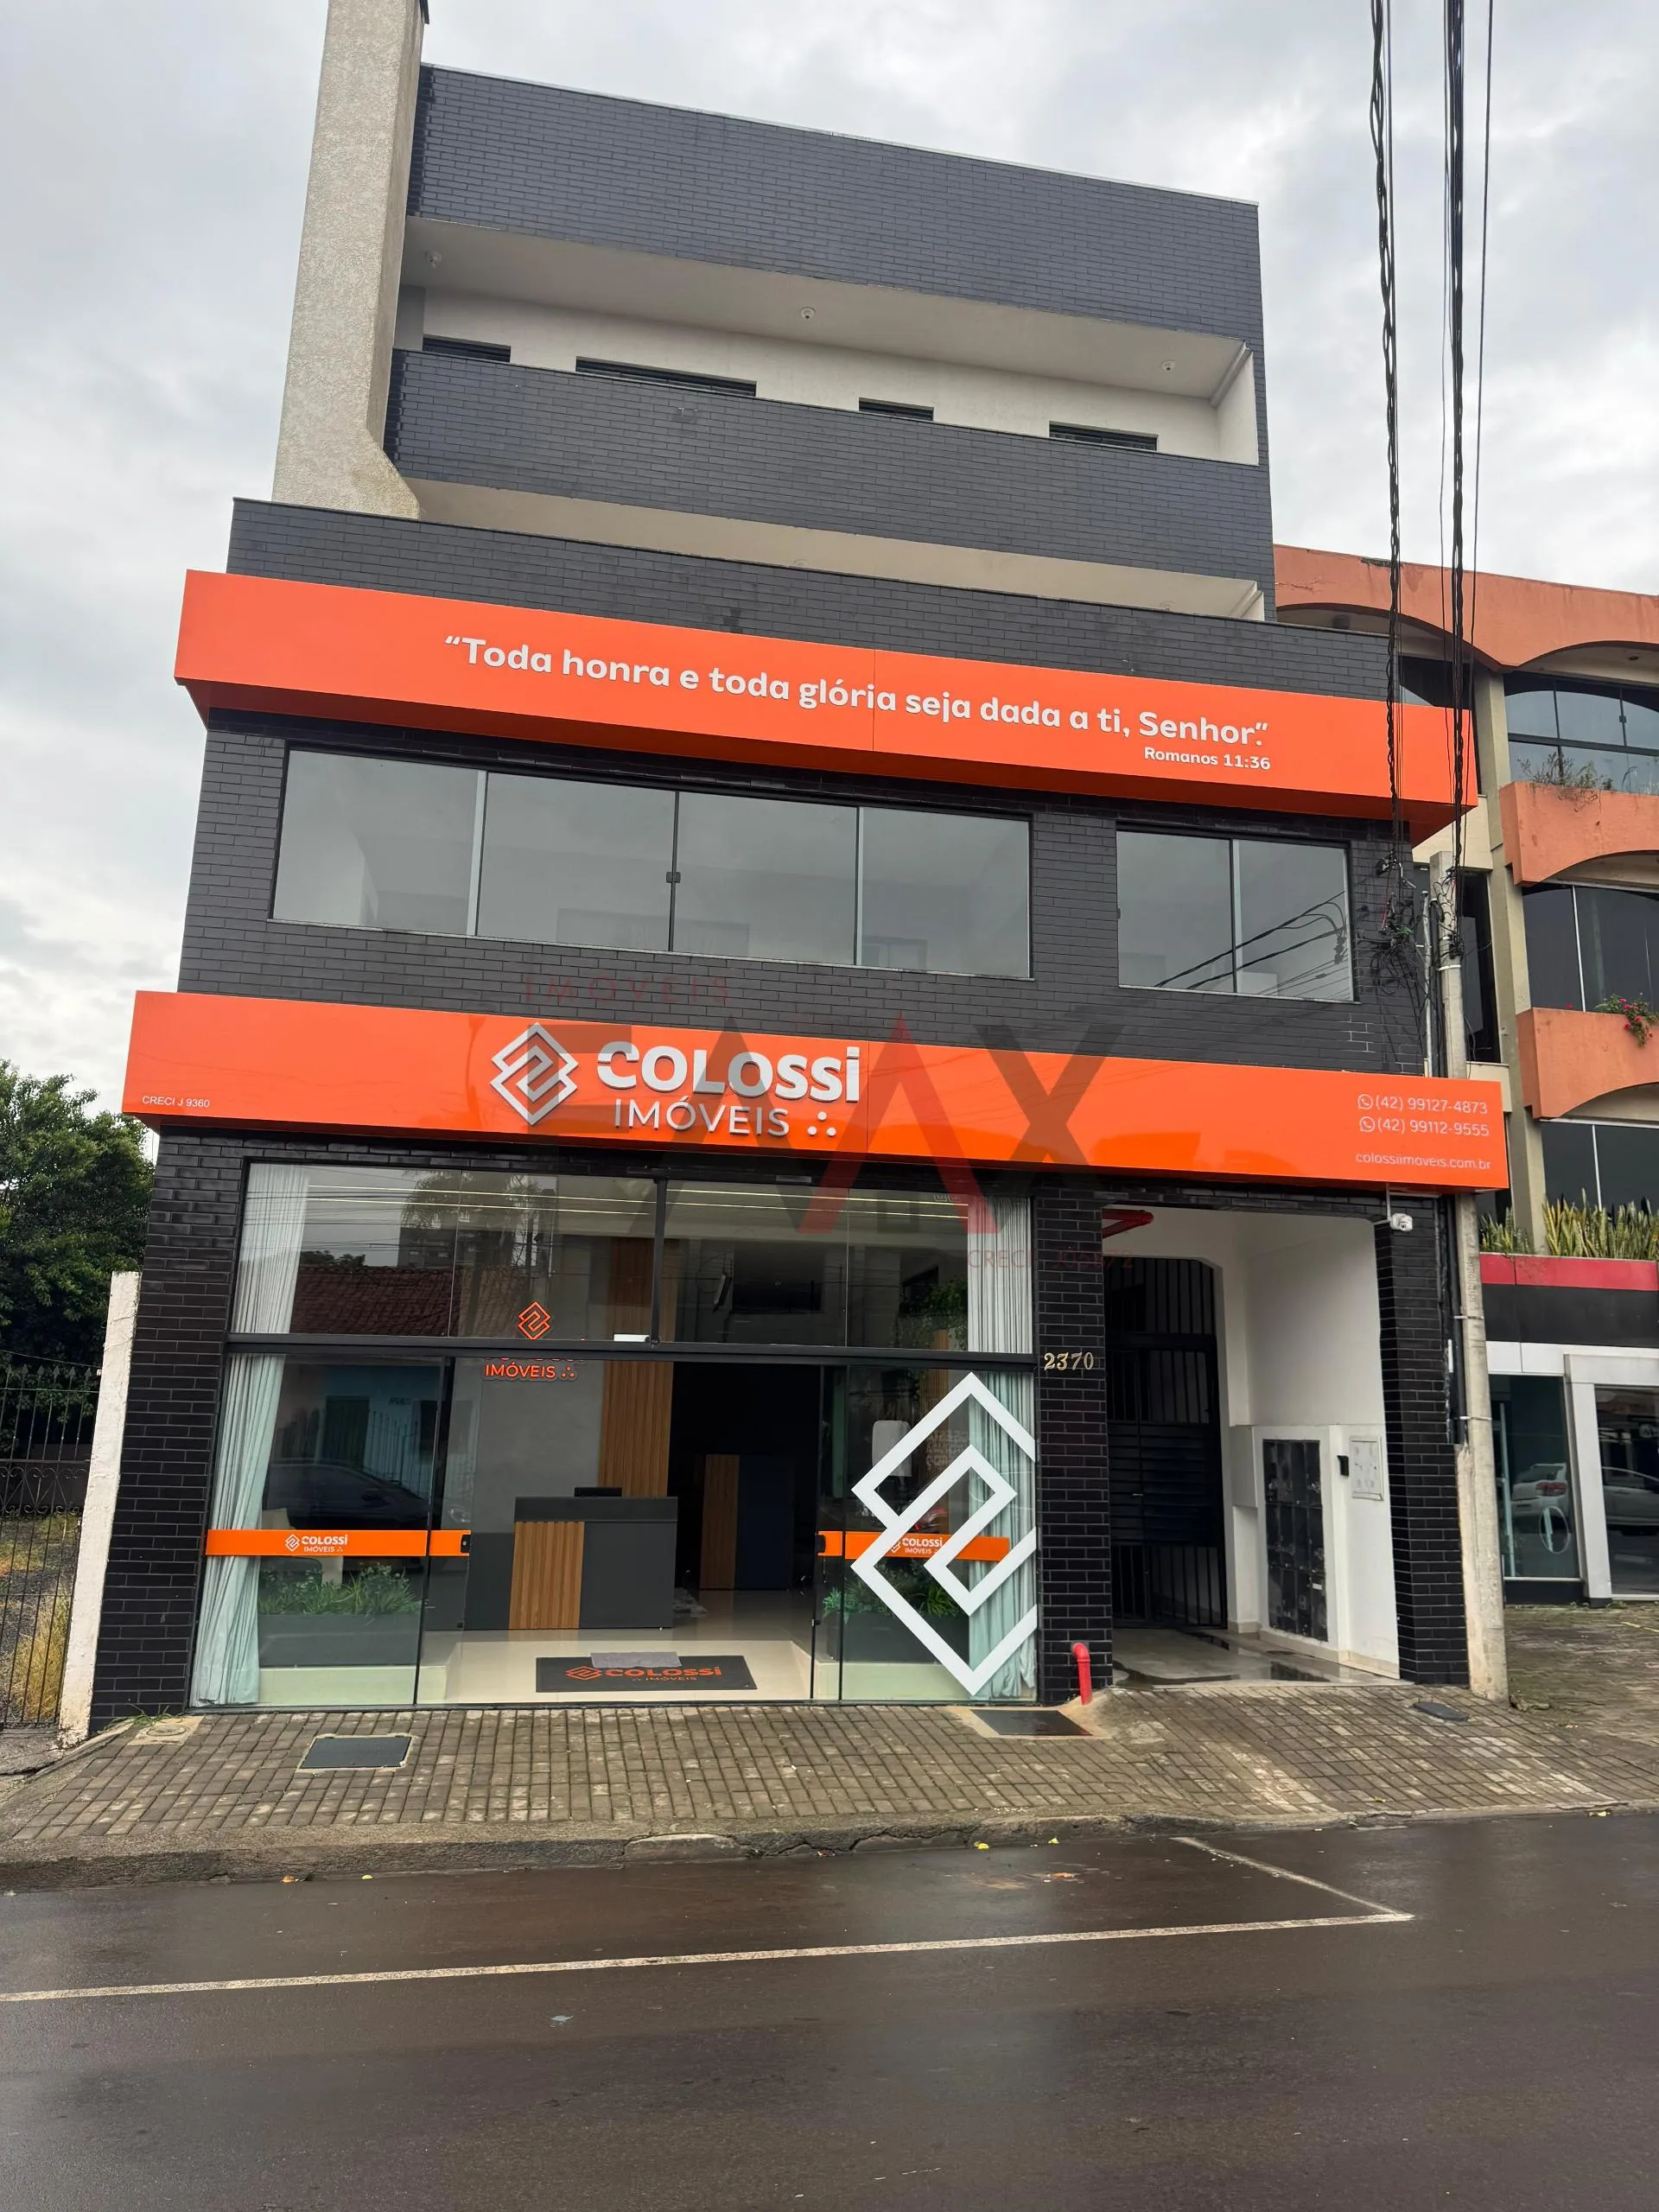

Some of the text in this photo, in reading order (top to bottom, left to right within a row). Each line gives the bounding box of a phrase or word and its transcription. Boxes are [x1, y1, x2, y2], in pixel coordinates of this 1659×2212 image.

[563, 649, 669, 687] honra
[679, 670, 699, 690] e
[709, 667, 789, 700] toda
[799, 679, 896, 710] glória
[906, 691, 970, 723] seja
[980, 697, 1060, 728] dada
[1070, 710, 1089, 730] a
[1096, 708, 1130, 738] ti,
[1144, 747, 1271, 771] Romanos 11:36
[143, 1096, 210, 1108] CRECI J 9360
[1376, 1095, 1488, 1115] (42) 99127-4873
[614, 1096, 790, 1137] IMÓVEIS
[1377, 1116, 1490, 1137] (42) 99112-9555
[484, 1363, 556, 1379] IMÓVEIS
[1044, 1352, 1094, 1370] 2370
